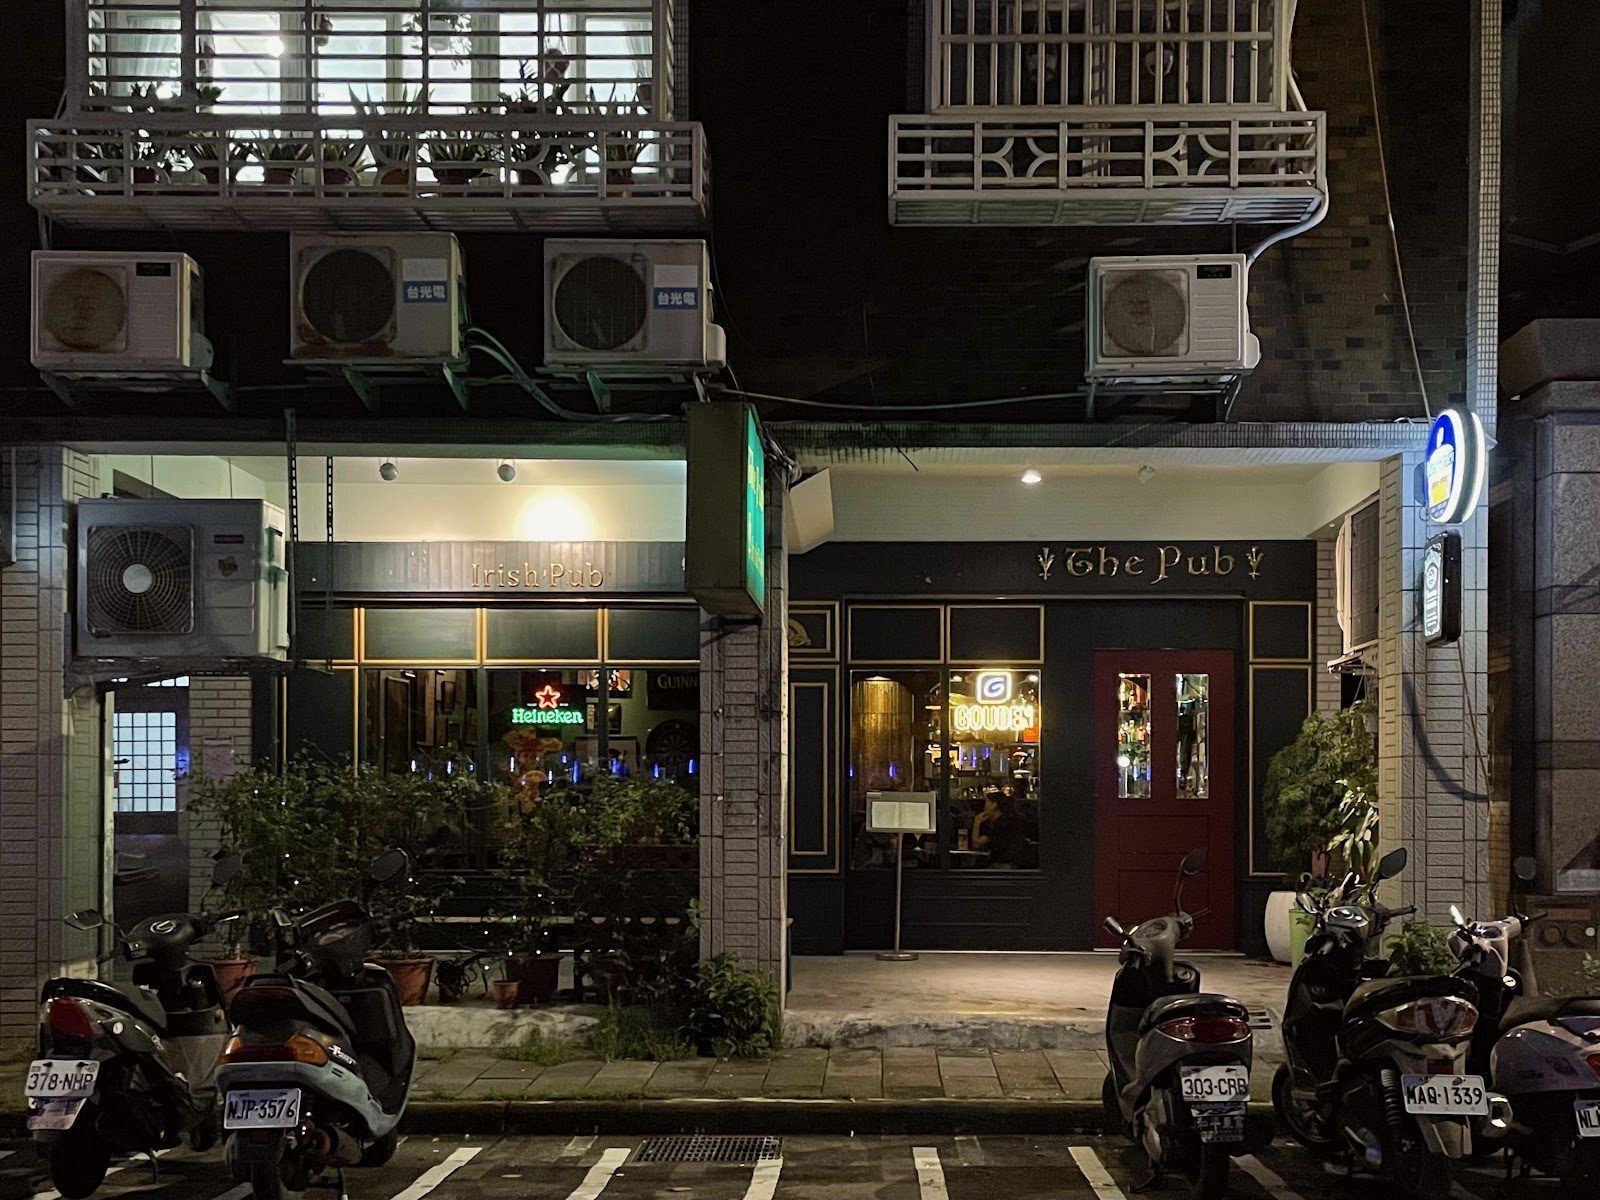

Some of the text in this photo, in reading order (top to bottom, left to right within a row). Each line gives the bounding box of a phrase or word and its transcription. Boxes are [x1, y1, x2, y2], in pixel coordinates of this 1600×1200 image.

[471, 562, 604, 588] Irish Pub
[1064, 545, 1236, 585] The Pub
[512, 708, 585, 723] Heineken
[1578, 1110, 1600, 1128] NL
